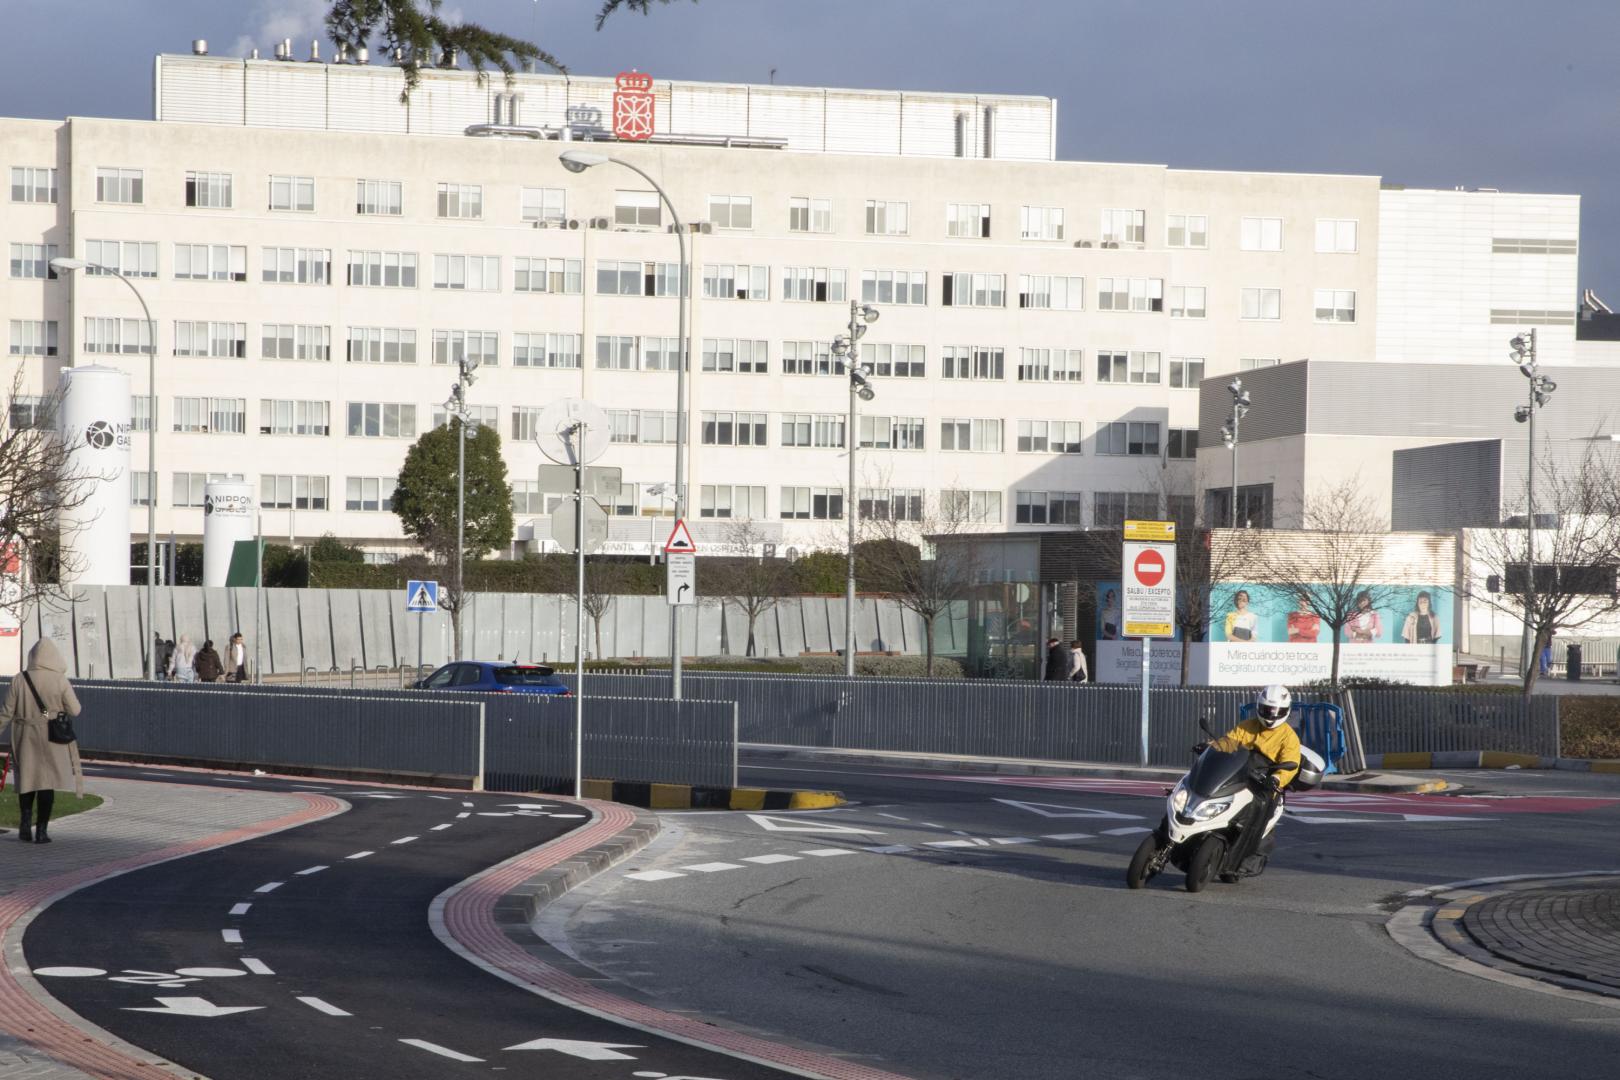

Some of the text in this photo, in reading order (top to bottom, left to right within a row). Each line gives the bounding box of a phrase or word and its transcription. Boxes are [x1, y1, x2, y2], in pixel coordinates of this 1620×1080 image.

[215, 495, 251, 504] NIPPON
[1127, 587, 1144, 595] SALBU
[1147, 588, 1171, 596] EXCEPTO
[1227, 649, 1318, 661] Mira cuándo te toca
[1218, 662, 1256, 675] Begiratu
